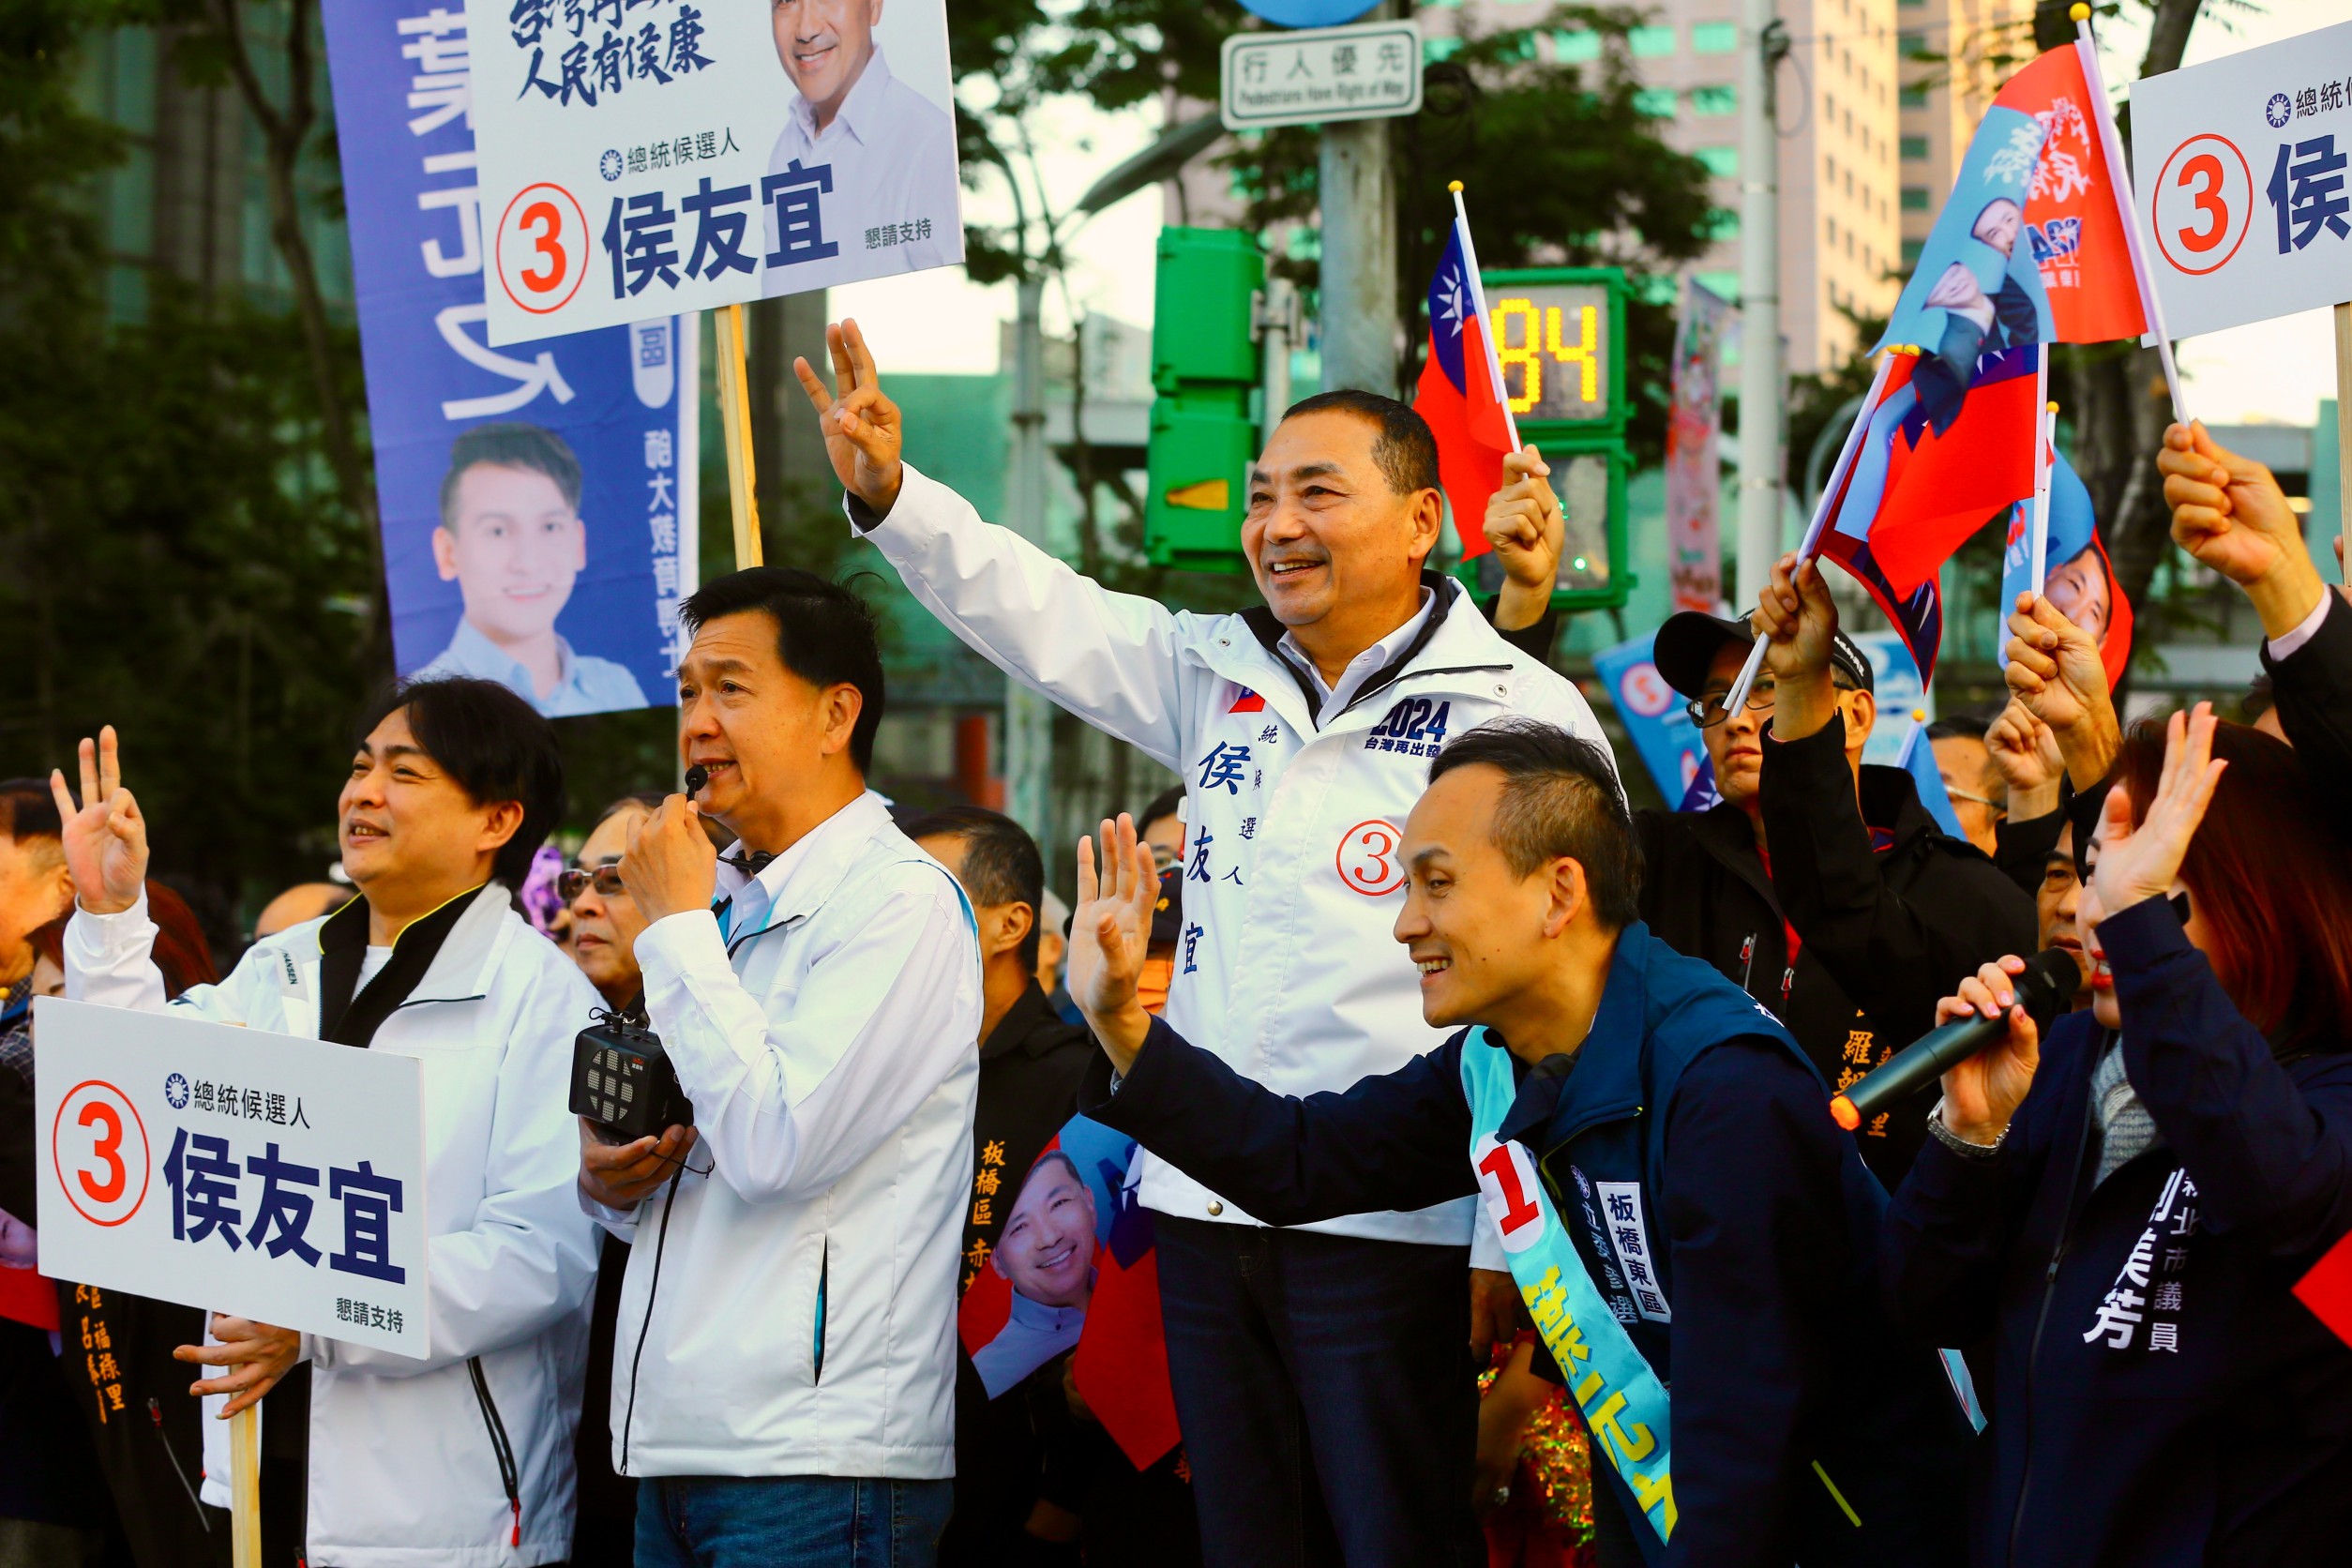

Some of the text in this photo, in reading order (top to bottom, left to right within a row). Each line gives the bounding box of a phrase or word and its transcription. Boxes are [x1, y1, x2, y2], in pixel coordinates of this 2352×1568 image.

[1243, 44, 1405, 83] 行人優先
[626, 127, 741, 175] 總統候選人
[519, 158, 840, 300] 3 侯友宜
[864, 218, 932, 250] 懇請支持
[2178, 154, 2229, 253] 3
[1490, 297, 1598, 414] 84
[1184, 740, 1251, 975] 侯友宜
[1353, 831, 1393, 884] 3
[193, 1079, 310, 1130] 總統候選人
[78, 1101, 406, 1286] 3 侯友宜
[1479, 1144, 1540, 1236] 1
[1606, 1193, 1666, 1315] 板橋東區
[336, 1297, 403, 1334] 懇請支持
